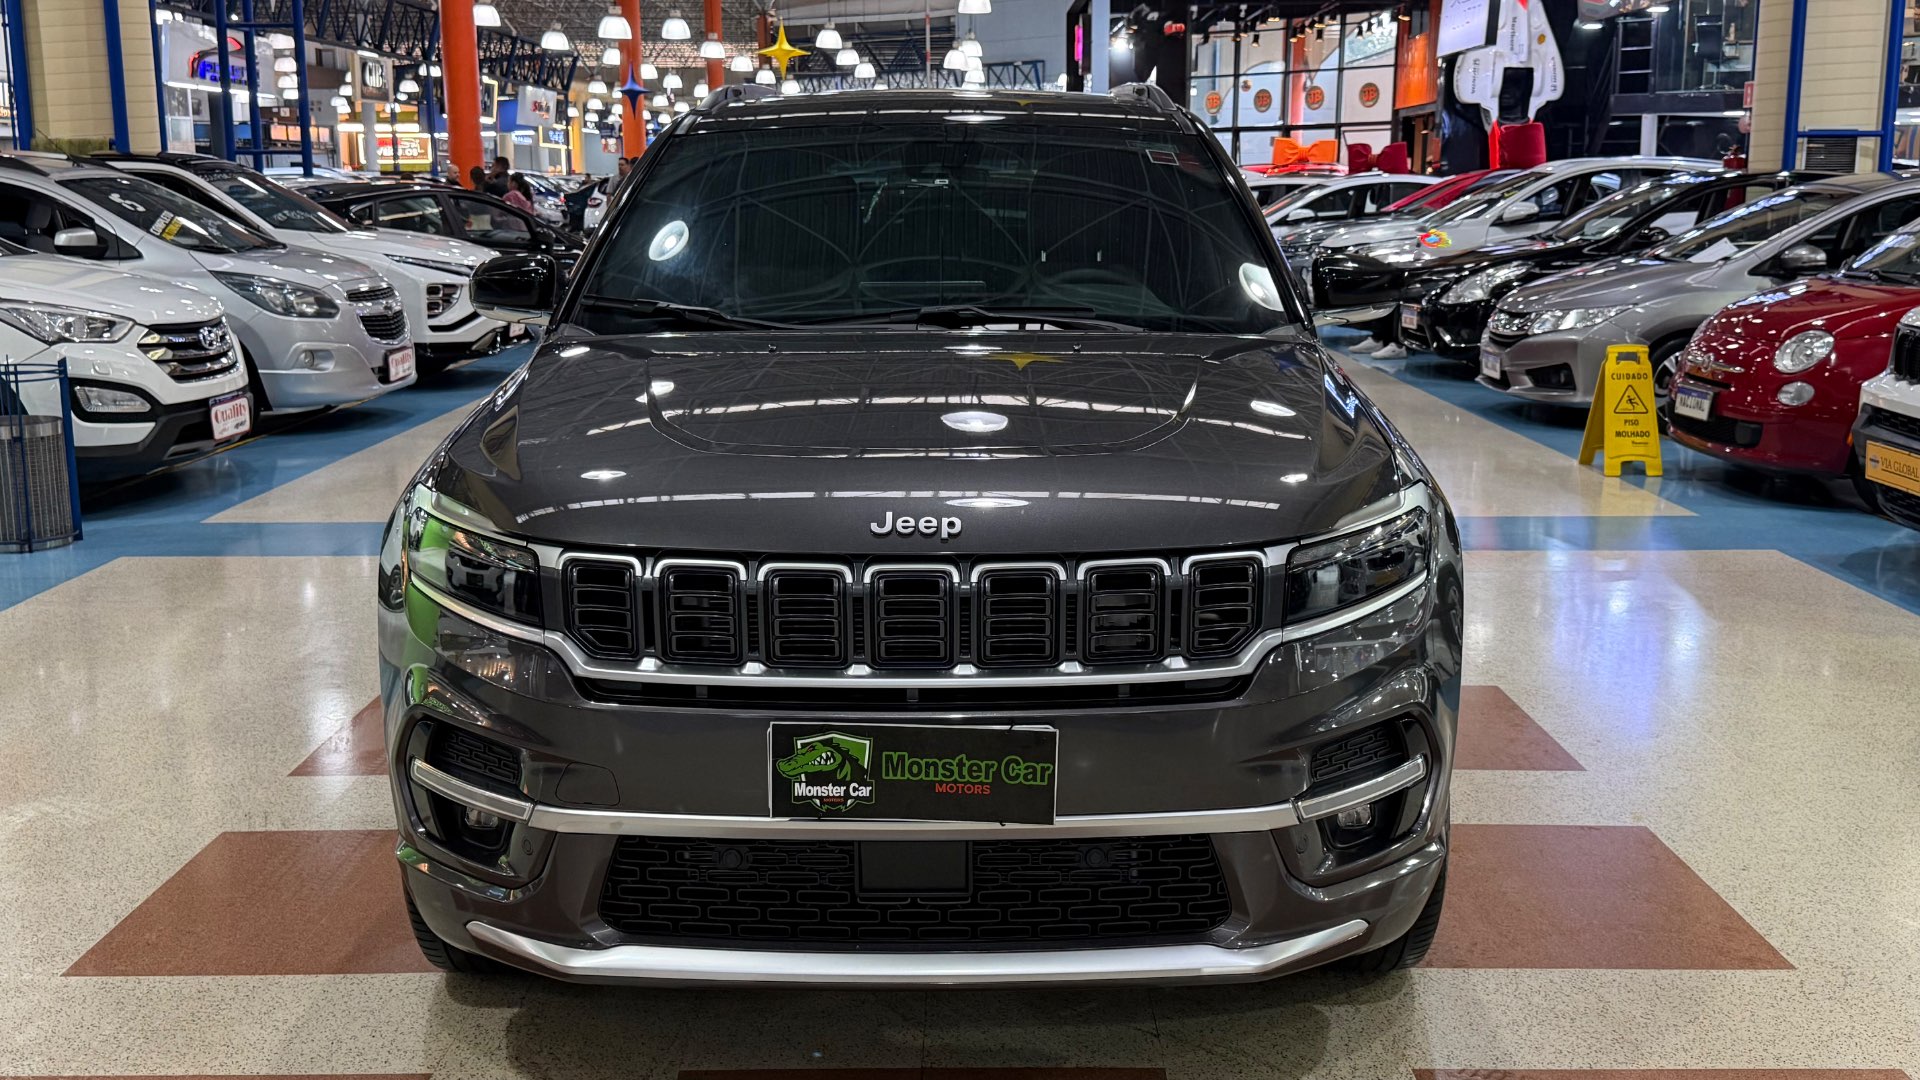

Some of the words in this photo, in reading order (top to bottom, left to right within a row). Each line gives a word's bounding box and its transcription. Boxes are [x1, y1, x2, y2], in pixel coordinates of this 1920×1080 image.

[1880, 456, 1893, 470] VIA
[1893, 460, 1920, 478] GLOBAL
[870, 511, 962, 540] Jeep
[882, 752, 998, 783] Monster
[1001, 755, 1053, 785] Car
[794, 782, 847, 797] Monster
[849, 782, 872, 797] Car
[935, 783, 991, 795] MOTORS
